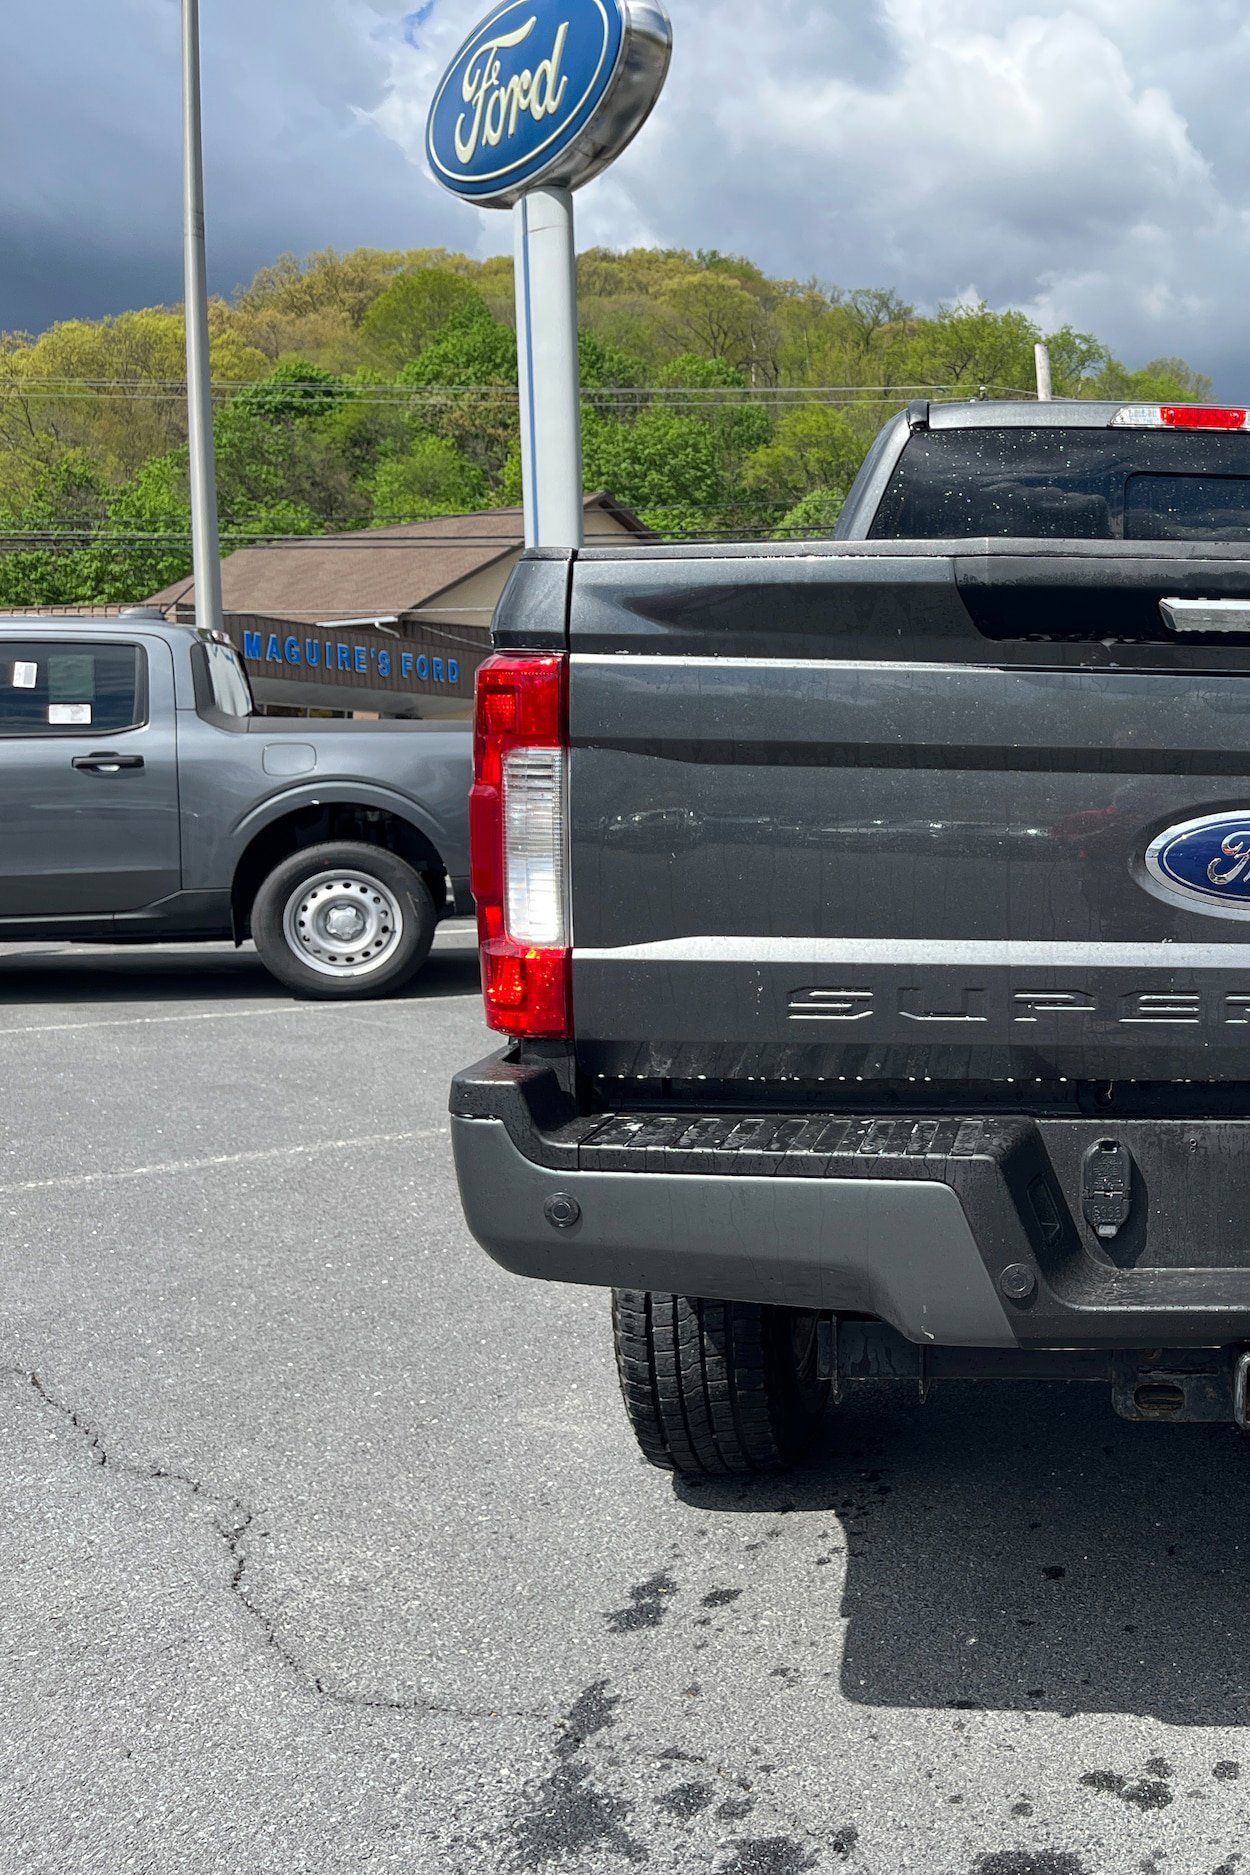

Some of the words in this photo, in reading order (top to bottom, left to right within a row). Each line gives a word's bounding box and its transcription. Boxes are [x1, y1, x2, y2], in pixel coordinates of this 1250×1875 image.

[454, 15, 569, 165] Ford
[243, 629, 392, 678] MAGUIRE'S
[401, 651, 461, 684] FORD
